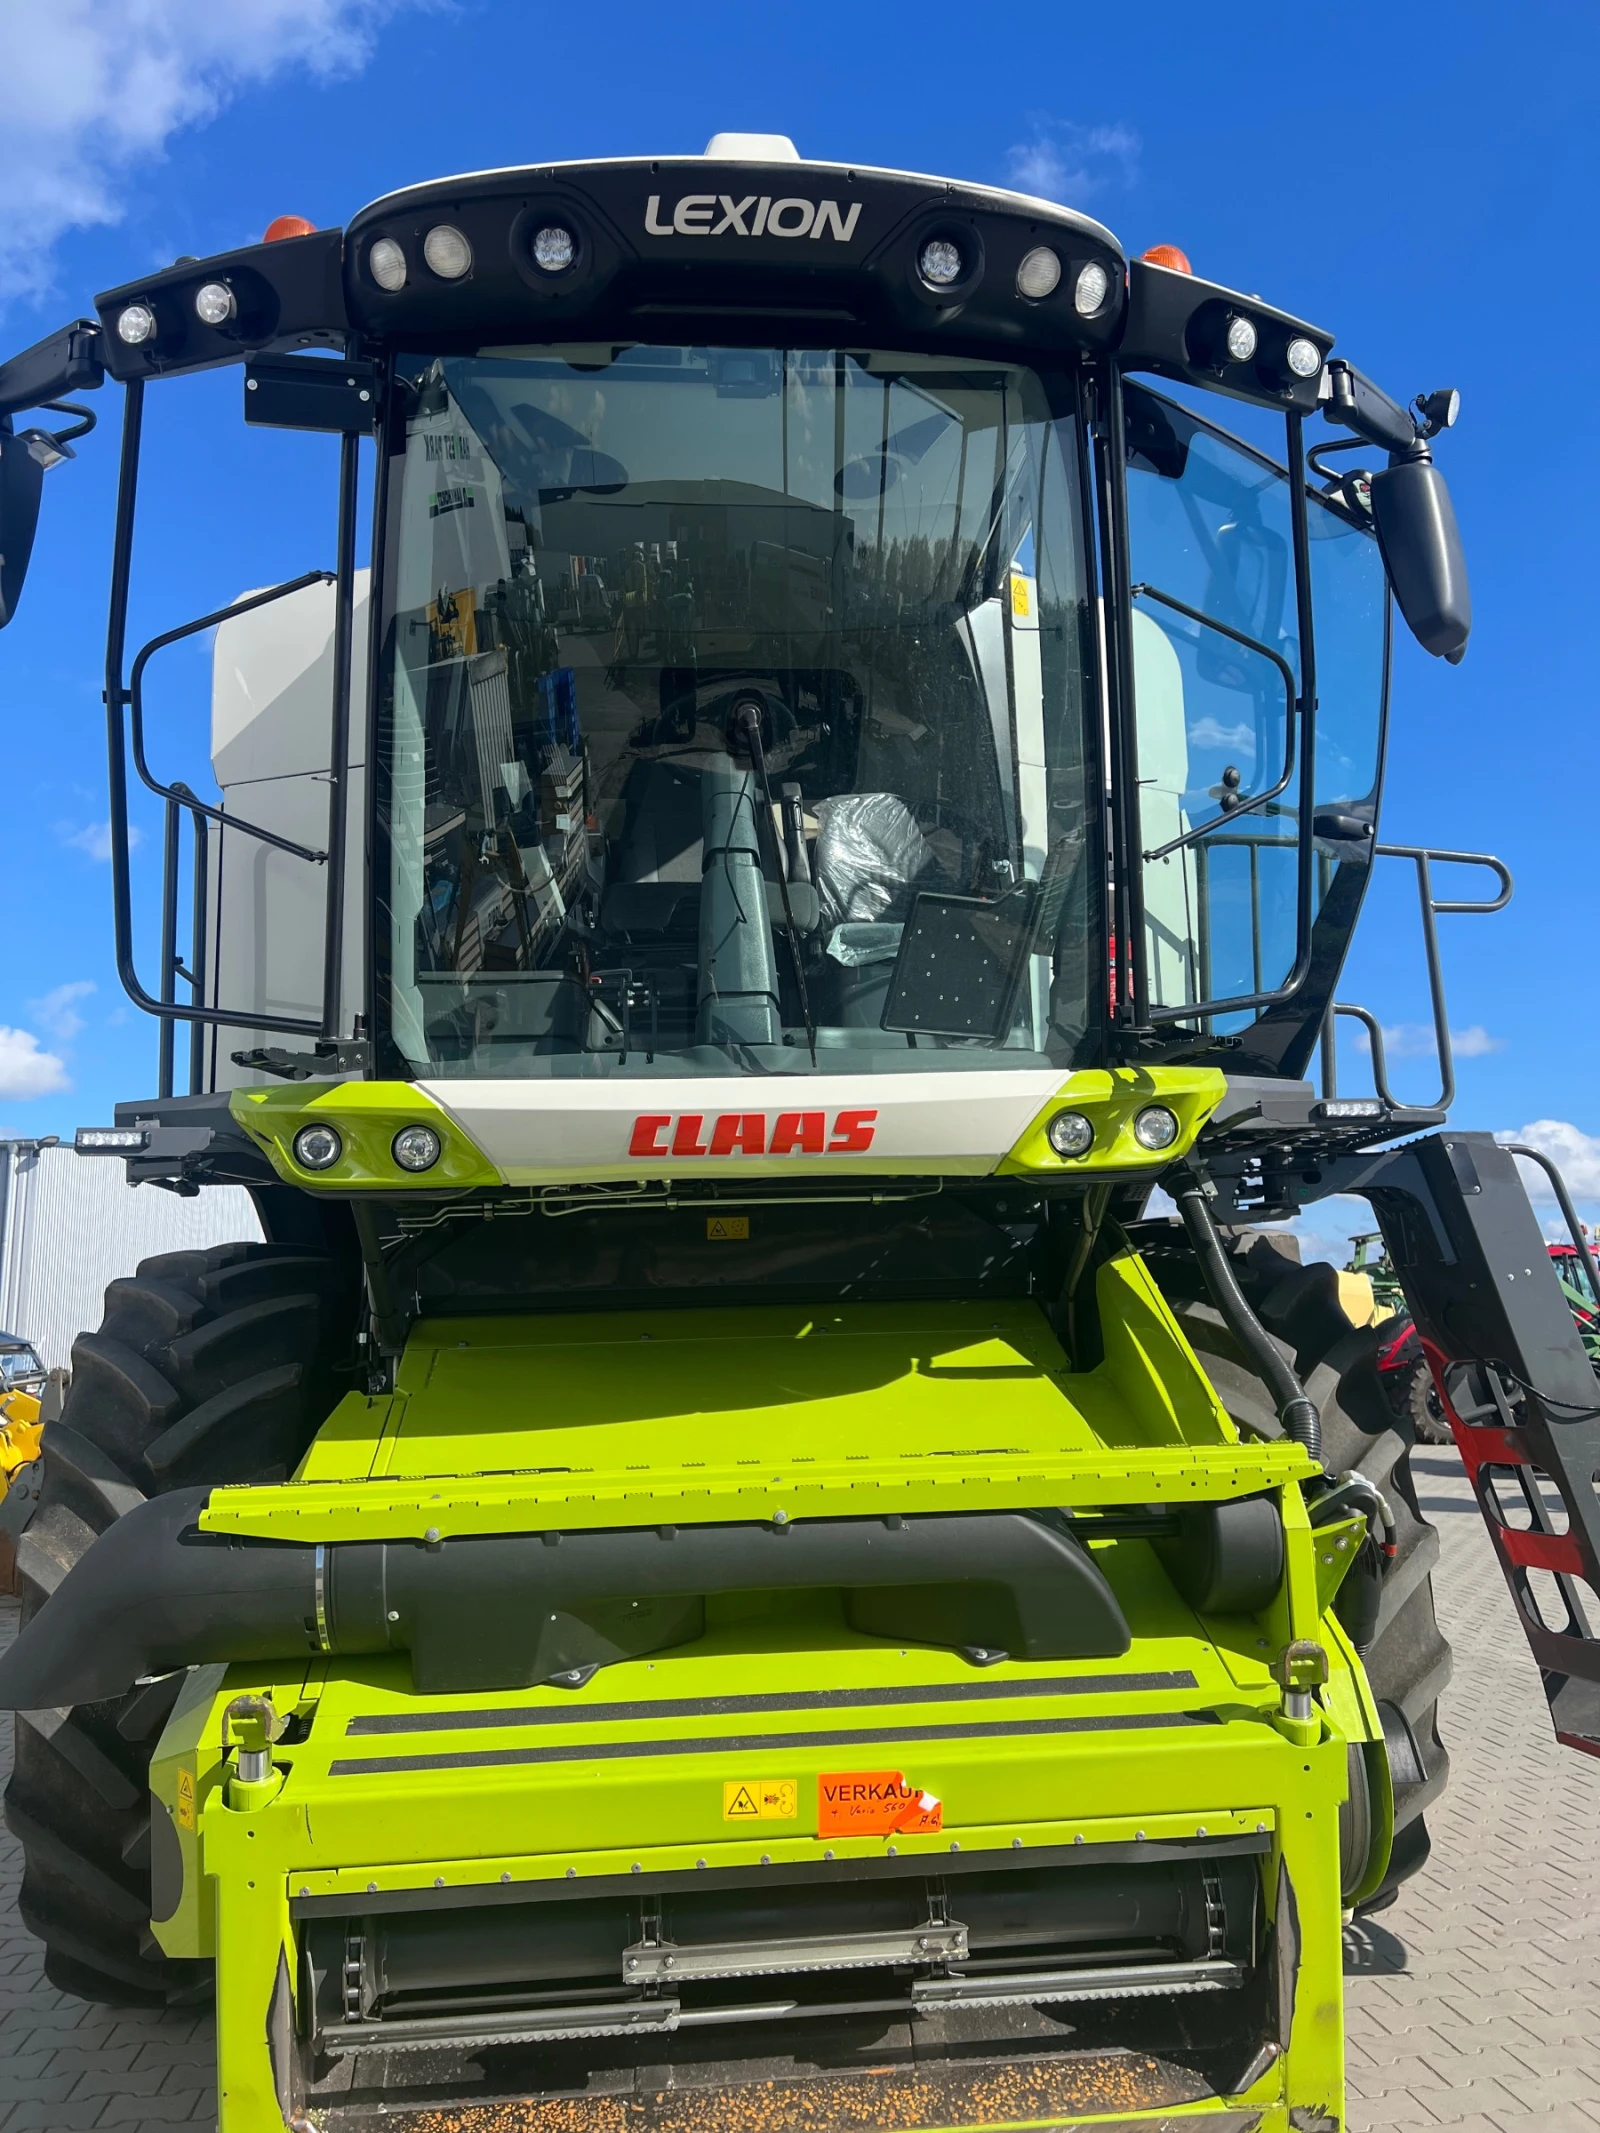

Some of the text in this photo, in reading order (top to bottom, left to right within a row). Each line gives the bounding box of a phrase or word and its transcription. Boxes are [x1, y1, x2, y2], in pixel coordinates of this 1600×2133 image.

[644, 195, 862, 242] LEXION
[628, 1109, 879, 1157] CLAAS
[883, 1802, 906, 1813] 560
